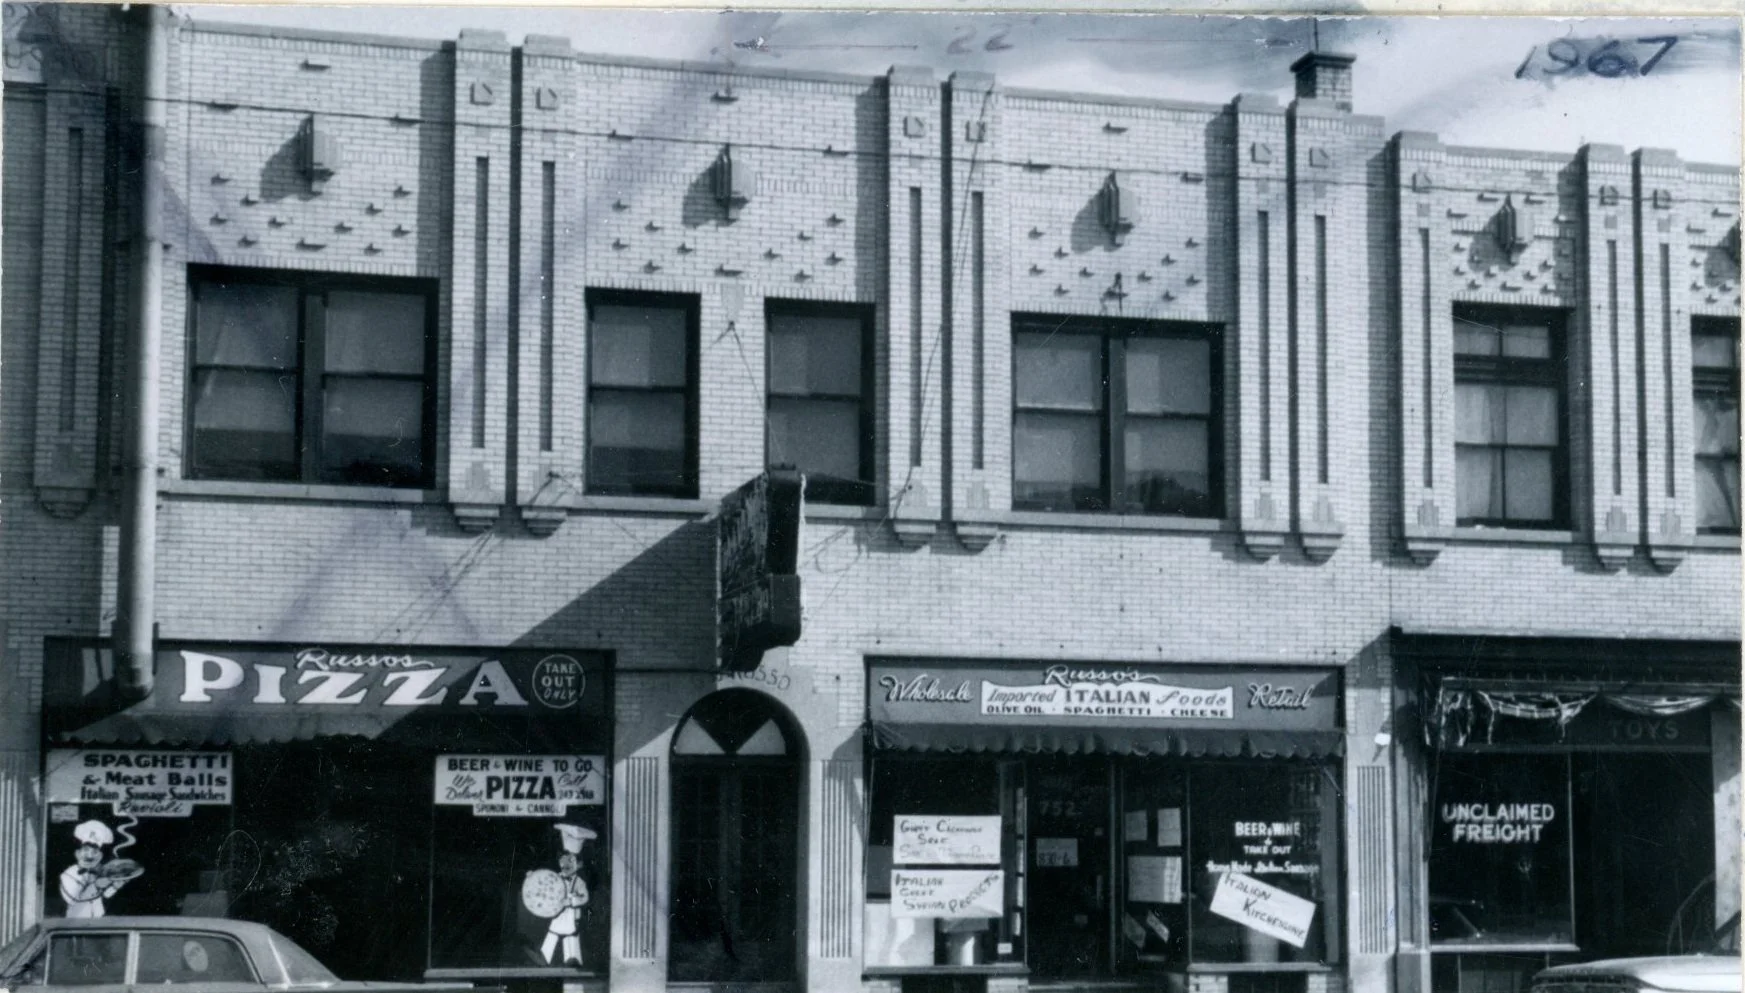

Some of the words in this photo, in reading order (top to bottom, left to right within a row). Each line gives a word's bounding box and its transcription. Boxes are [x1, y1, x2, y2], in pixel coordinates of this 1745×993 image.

[296, 648, 434, 670] Russos
[544, 663, 577, 674] TAKE
[179, 650, 529, 705] PIZZA
[541, 675, 576, 688] OUT
[543, 687, 576, 701] ONLY
[878, 674, 974, 702] Wholesale
[1247, 682, 1316, 709] Retail
[987, 688, 1057, 705] Imported
[1065, 689, 1151, 704] ITALIAN
[986, 705, 1018, 714] OLIVE
[1023, 705, 1043, 714] OIL
[1063, 706, 1151, 716] SPAGHETTI
[1170, 708, 1228, 718] CHEESE
[1611, 720, 1680, 740] TOYS
[83, 754, 228, 769] SPAGHETTI
[447, 758, 491, 772] BEER
[504, 759, 544, 772] WINE
[553, 759, 569, 773] TO
[575, 760, 594, 773] GO
[82, 774, 102, 786] &
[105, 771, 157, 786] Meat
[167, 772, 228, 786] Balls
[80, 785, 120, 800] Italian
[485, 775, 557, 800] PIZZA
[1039, 800, 1078, 817] 752
[1442, 803, 1555, 822] UNCLAIMED
[1234, 821, 1267, 837] BEER
[1272, 821, 1301, 837] WINE
[1451, 824, 1545, 843] FREIGHT
[1243, 845, 1268, 855] TAKE
[1272, 845, 1292, 855] OUT
